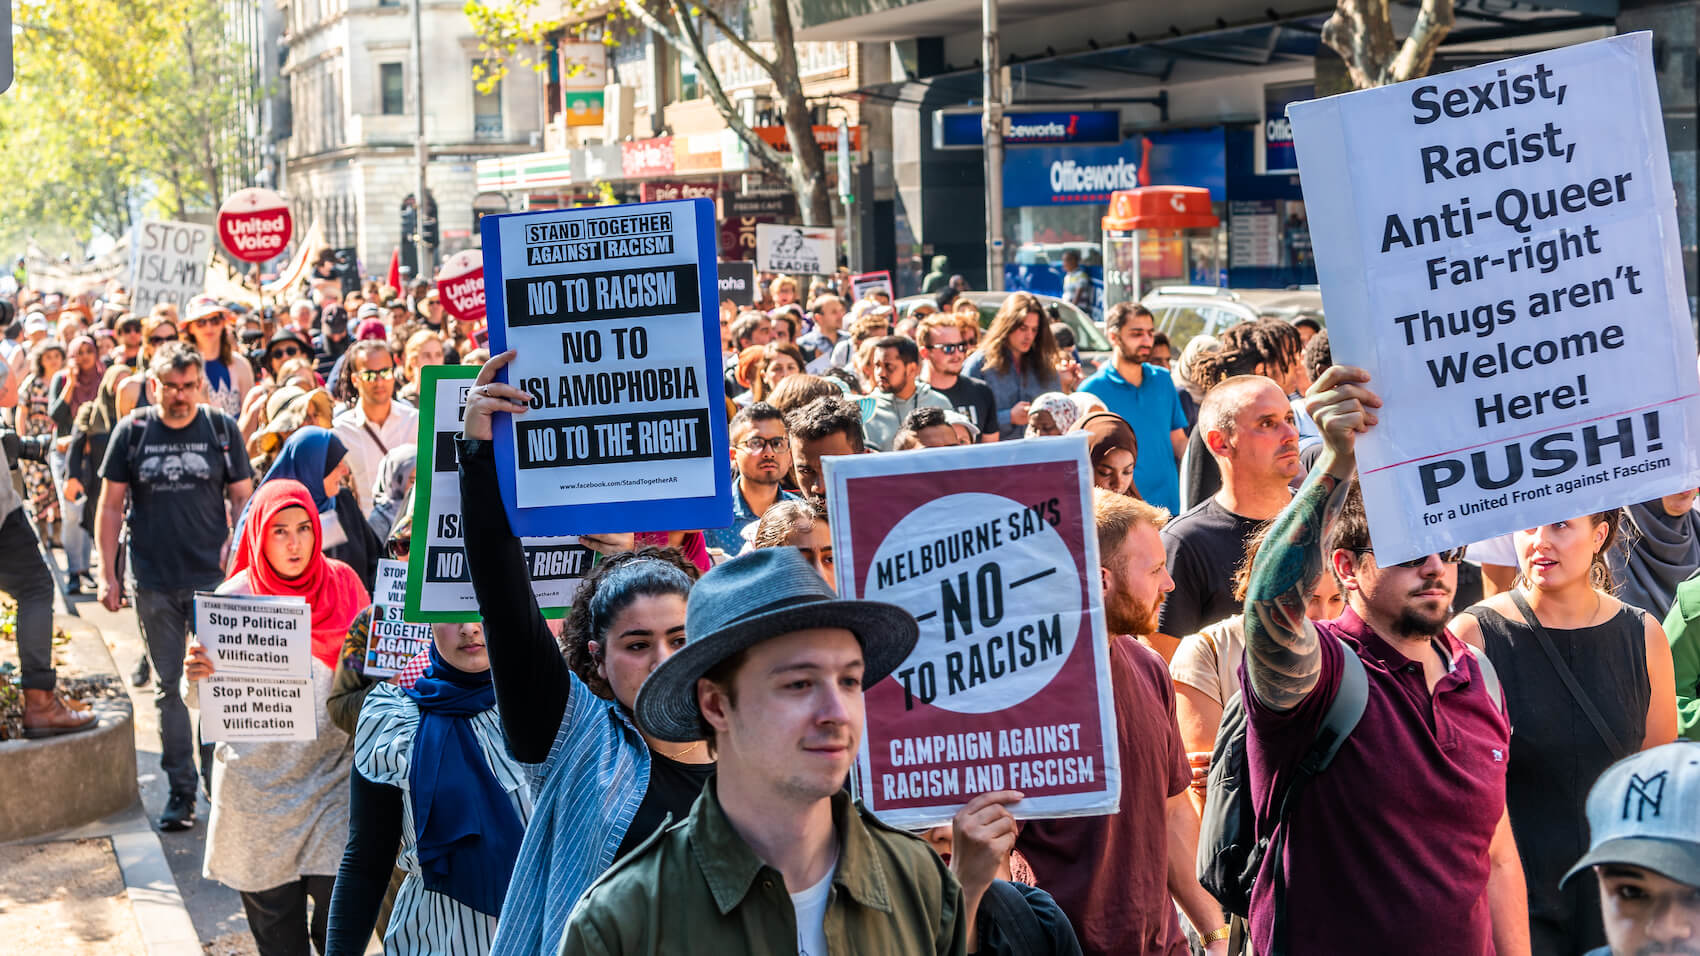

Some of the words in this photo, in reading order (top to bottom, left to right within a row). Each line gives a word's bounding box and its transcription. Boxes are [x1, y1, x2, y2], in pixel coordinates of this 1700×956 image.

[1411, 63, 1567, 125] Sexist,
[1420, 122, 1576, 184] Racist,
[1050, 157, 1137, 192] Officeworks
[227, 215, 285, 235] United
[530, 222, 580, 242] STAND
[589, 215, 670, 237] TOGETHER
[1380, 171, 1632, 253] Anti-Queer
[145, 223, 206, 256] STOP
[233, 234, 282, 251] Voice
[531, 242, 598, 265] AGAINST
[607, 236, 670, 257] RACISM
[769, 260, 819, 273] LEADER
[1426, 224, 1602, 291] Far-right
[445, 277, 485, 300] Unite
[453, 292, 486, 312] Voic
[527, 281, 557, 316] NO
[562, 278, 588, 313] TO
[595, 271, 677, 311] RACISM
[1394, 299, 1516, 346] Thugs
[1528, 264, 1643, 317] aren’t
[562, 329, 601, 364] NO
[611, 326, 648, 360] TO
[1426, 324, 1624, 388] Welcome
[520, 366, 699, 410] ISLAMOPHOBIA
[1475, 374, 1590, 428] Here!
[528, 428, 557, 463] NO
[562, 424, 591, 460] TO
[594, 421, 633, 458] THE
[638, 417, 699, 455] RIGHT
[1418, 410, 1663, 506] PUSH!
[559, 476, 678, 490] www.facebook.com/StandTogetherAR
[1423, 510, 1444, 526] for
[1447, 508, 1456, 520] a
[1460, 494, 1508, 517] United
[1512, 484, 1552, 504] Front
[1555, 470, 1610, 494] against
[1613, 455, 1670, 480] Fascism
[876, 518, 1002, 590] MELBOURNE
[1008, 498, 1061, 541] SAYS
[384, 567, 406, 578] STOP
[436, 552, 464, 578] NO
[533, 549, 586, 577] RIGHT
[941, 562, 1004, 643] NO
[209, 613, 238, 629] Stop
[243, 616, 297, 630] Political
[376, 622, 432, 639] TOGETHE
[218, 633, 242, 644] and
[247, 634, 287, 647] Media
[218, 649, 289, 664] Vilification
[376, 638, 430, 654] AGAINS
[898, 661, 937, 711] TO
[946, 613, 1063, 696] RACISM
[213, 686, 242, 699] Stop
[247, 687, 301, 698] Political
[223, 703, 247, 713] and
[252, 703, 292, 713] Media
[223, 718, 294, 729] Vilification
[889, 731, 993, 766] CAMPAIGN
[998, 723, 1080, 755] AGAINST
[882, 767, 961, 800] RACISM
[965, 763, 1005, 794] AND
[1009, 756, 1095, 789] FASCISM
